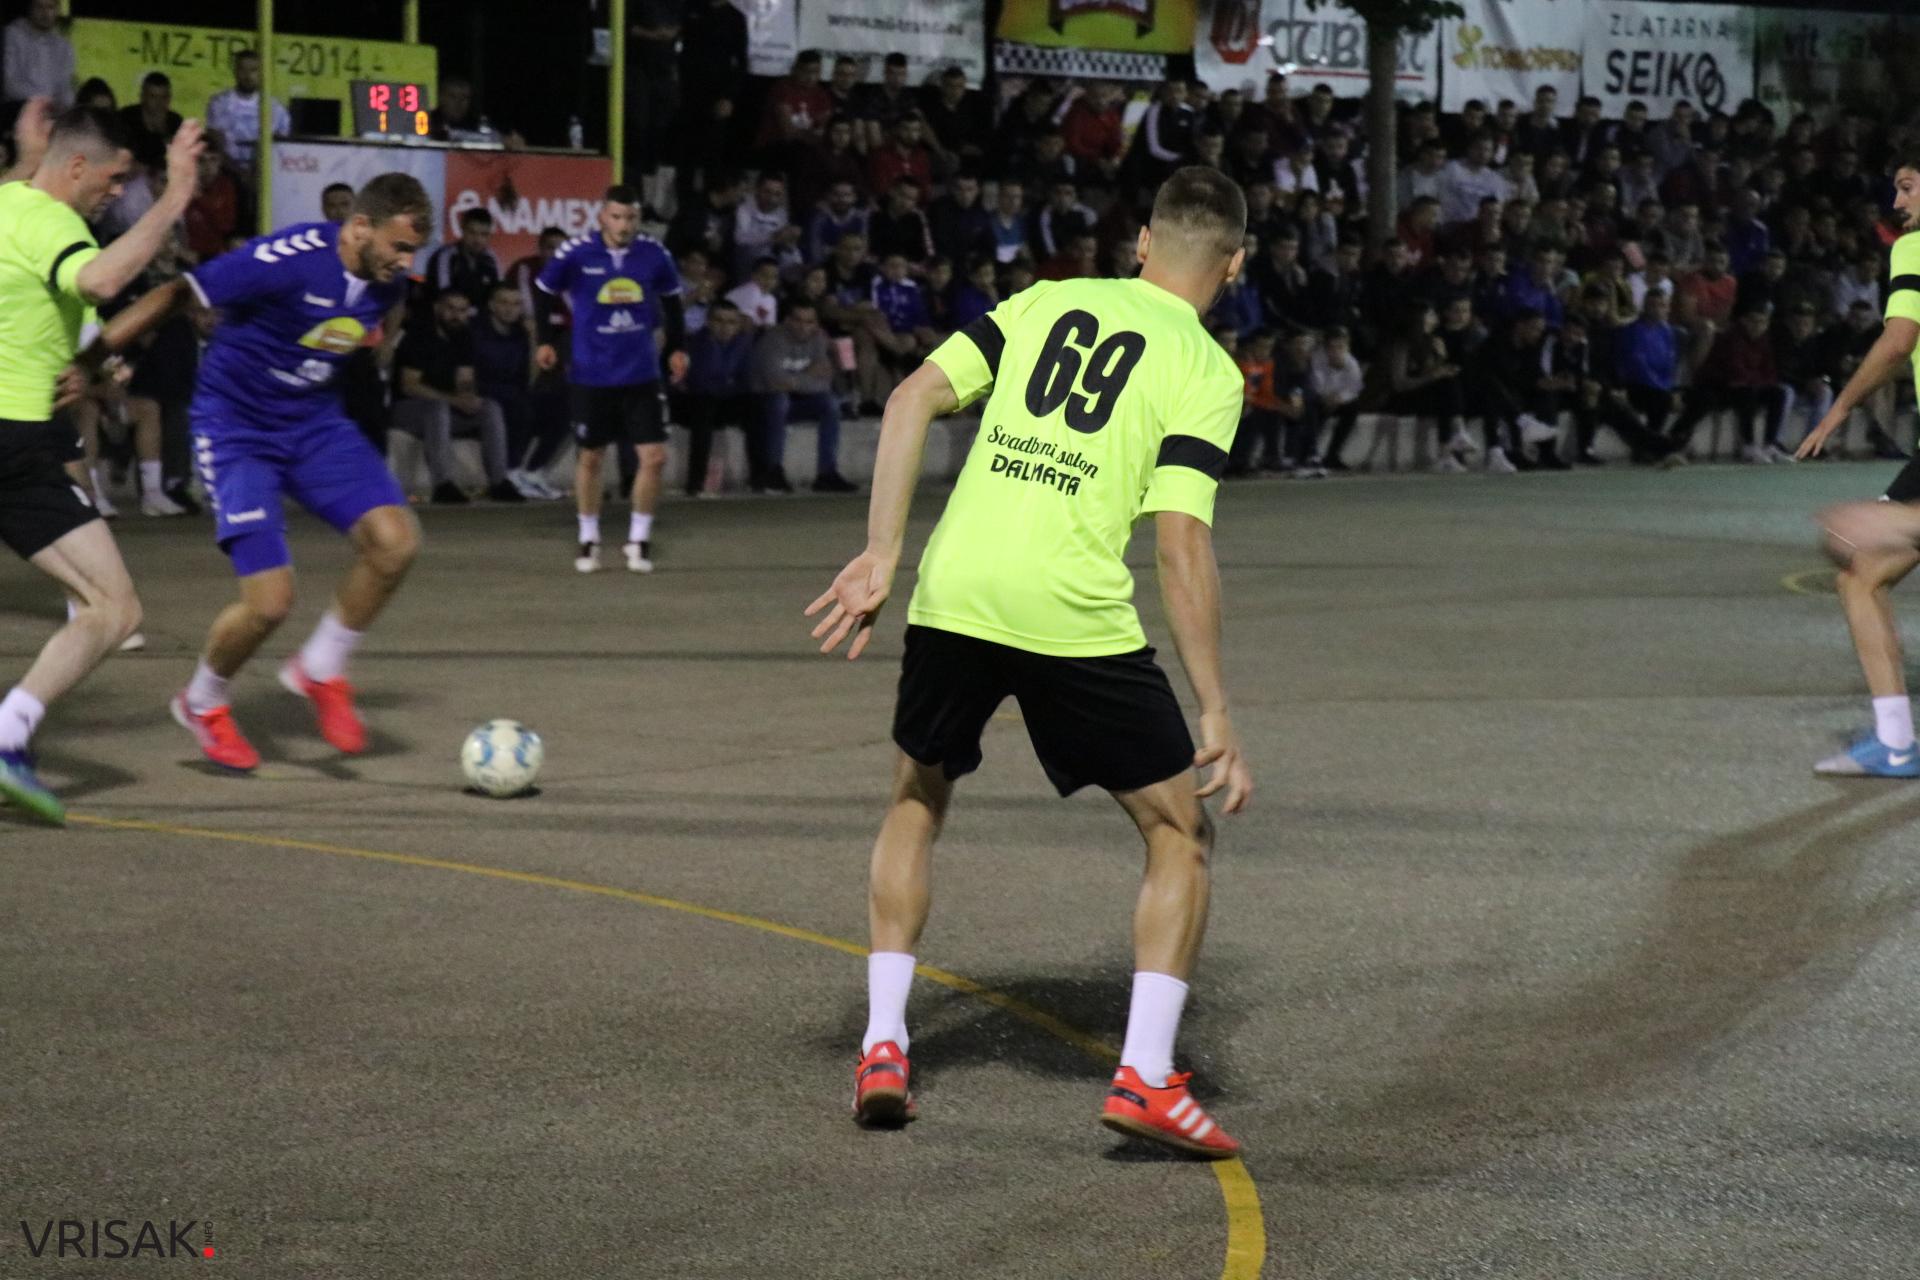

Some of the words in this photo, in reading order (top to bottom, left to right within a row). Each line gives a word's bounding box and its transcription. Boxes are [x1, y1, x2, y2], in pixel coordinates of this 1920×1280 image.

[1610, 13, 1729, 39] ZLATARNA
[369, 84, 390, 111] 12
[399, 84, 419, 112] 13
[1605, 49, 1725, 107] SEIKO
[379, 112, 387, 132] 1
[415, 111, 429, 135] 0
[1025, 309, 1146, 434] 69
[988, 425, 1062, 458] Svadbni
[1055, 451, 1099, 479] salon
